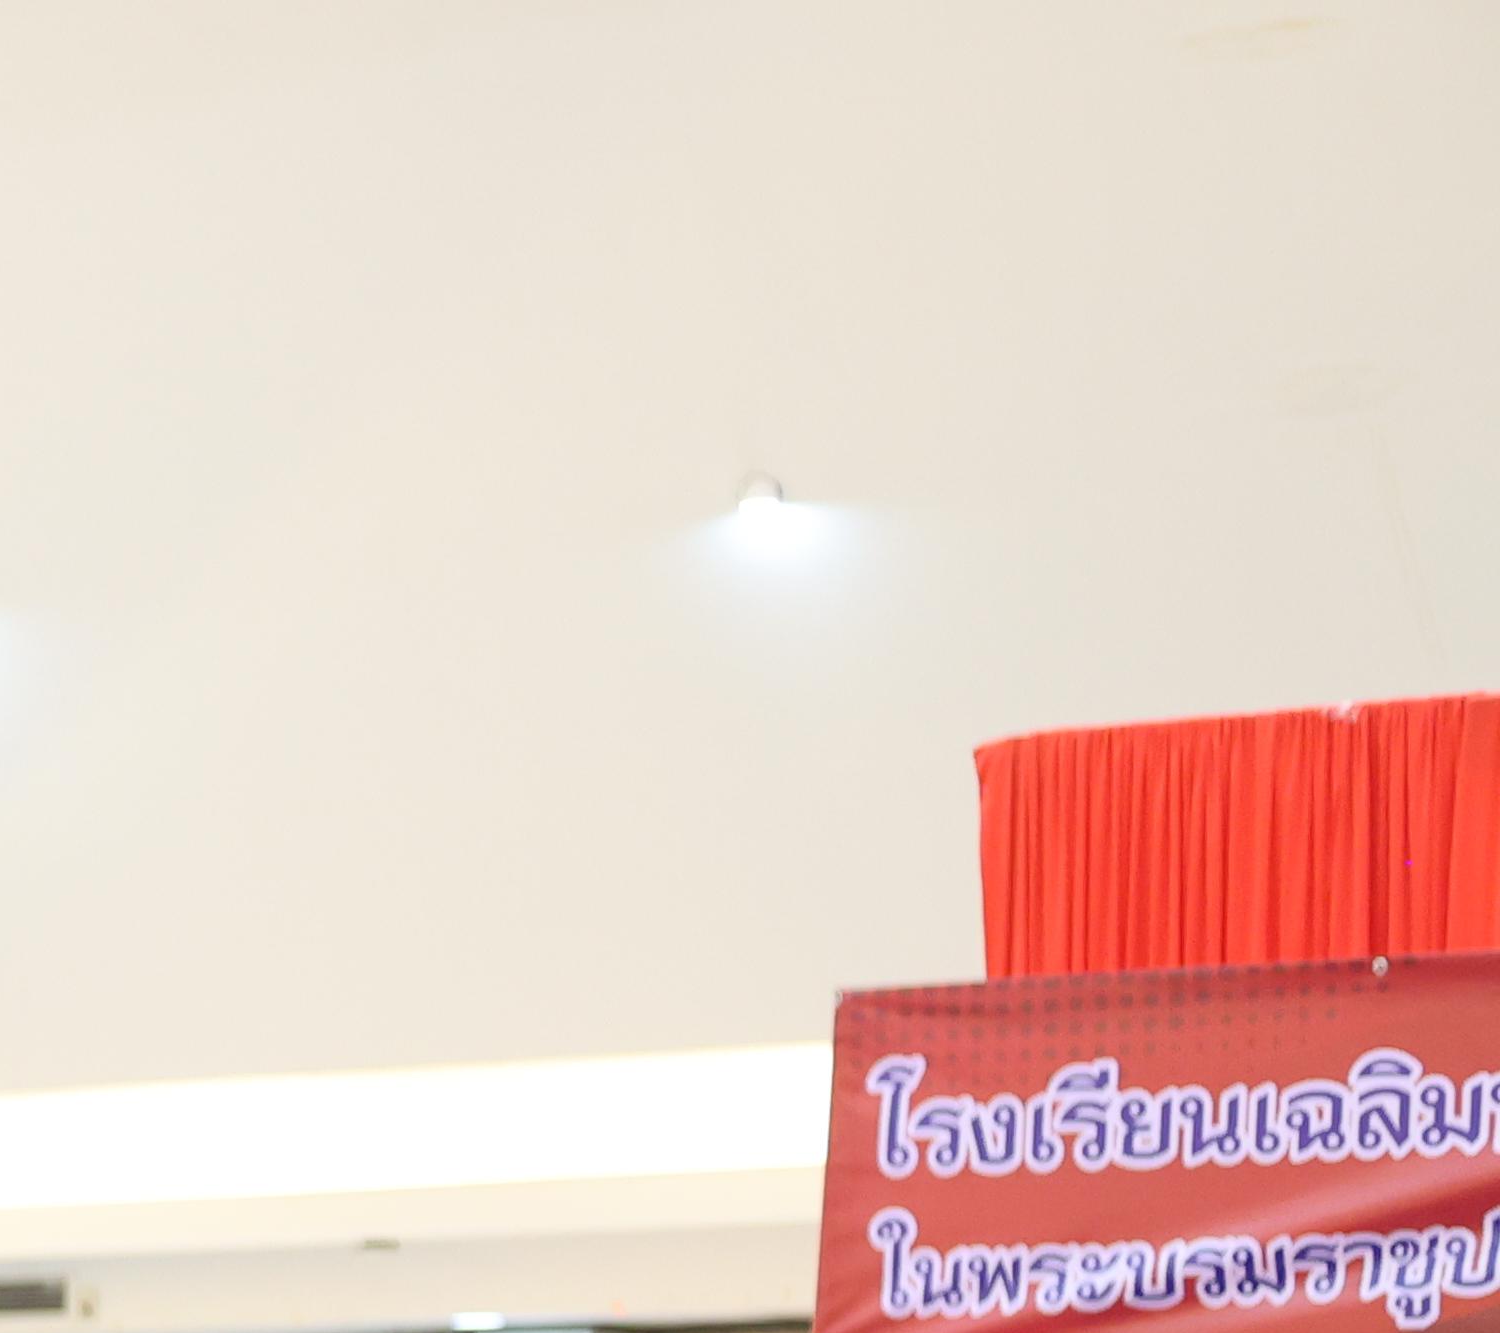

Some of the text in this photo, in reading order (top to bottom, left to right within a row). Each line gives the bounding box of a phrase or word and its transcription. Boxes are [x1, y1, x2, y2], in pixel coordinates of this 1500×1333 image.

[866, 1046, 1500, 1178] โรงเรียนเฉลิม
